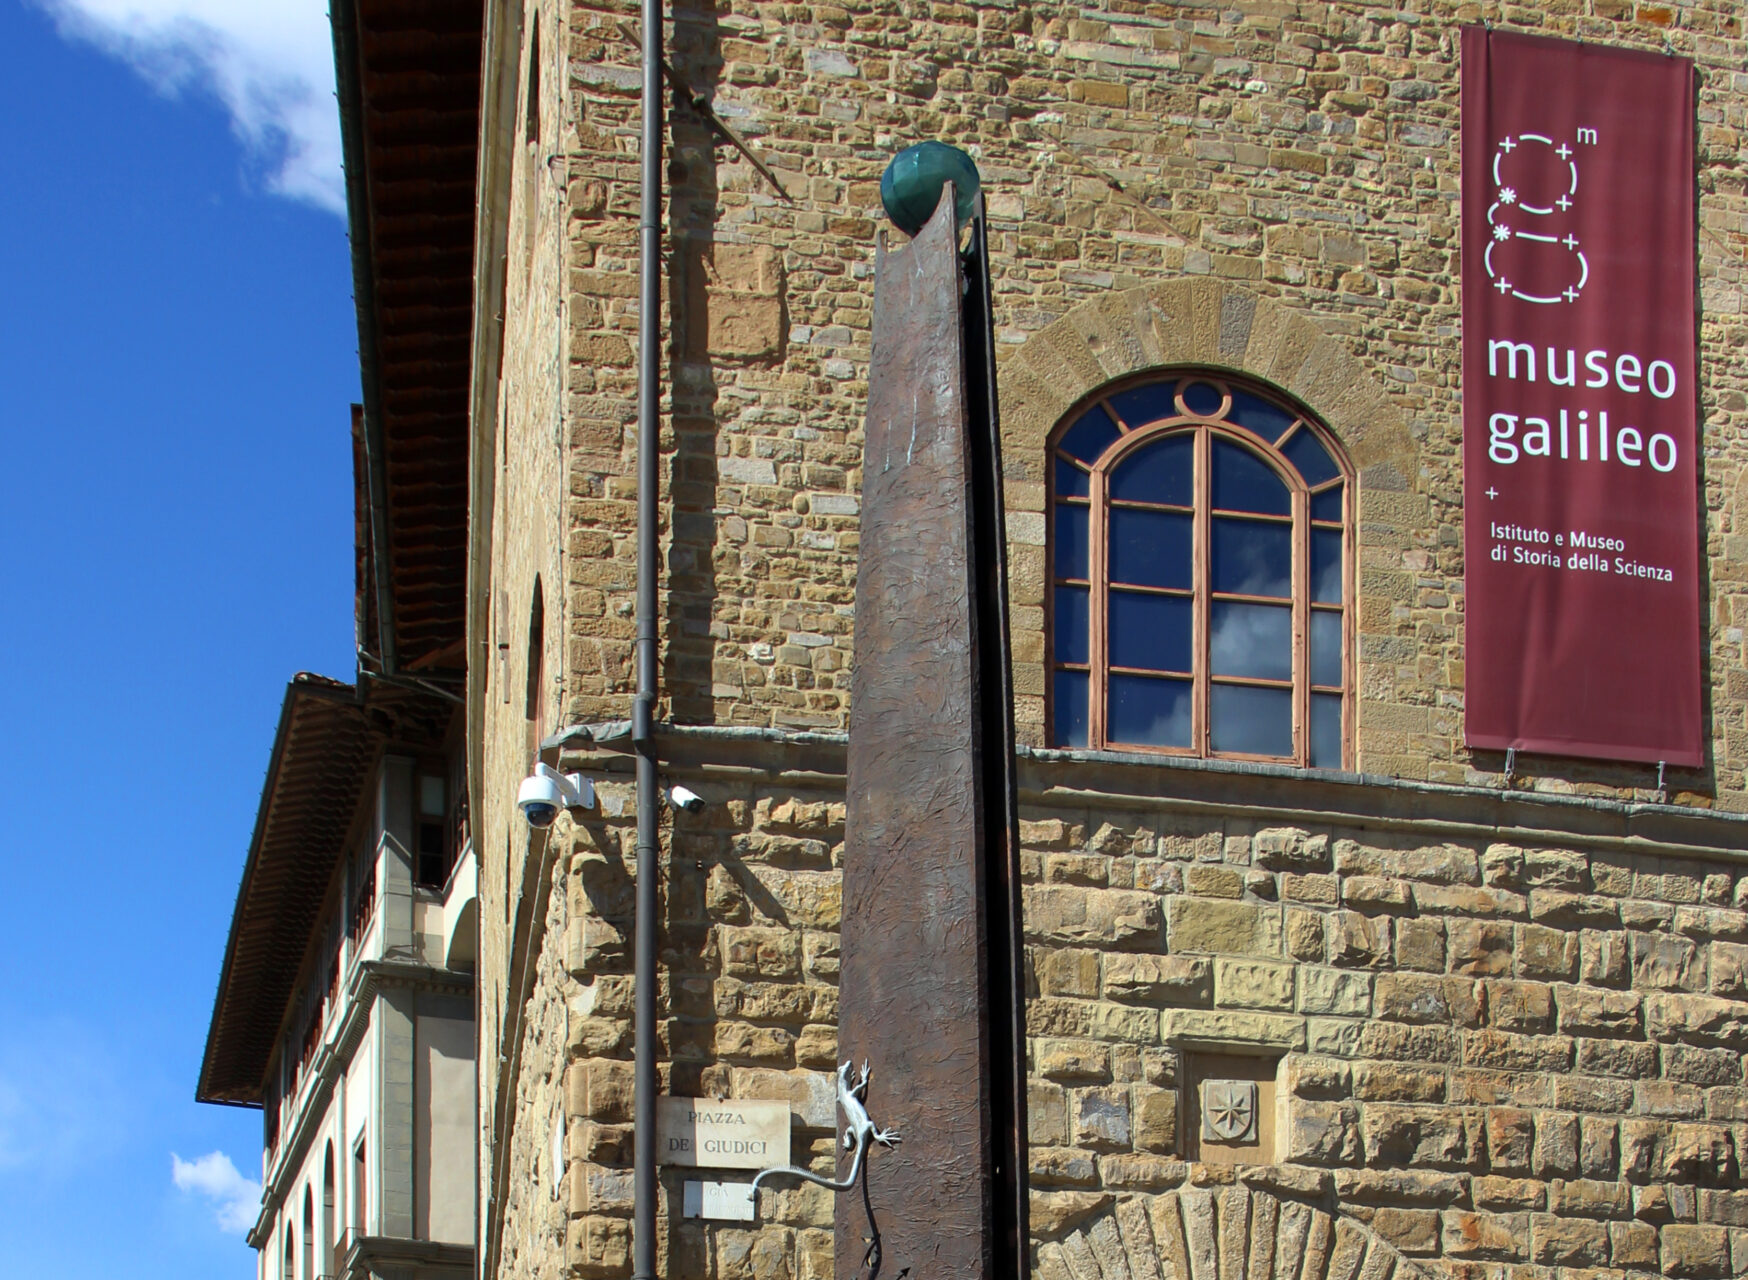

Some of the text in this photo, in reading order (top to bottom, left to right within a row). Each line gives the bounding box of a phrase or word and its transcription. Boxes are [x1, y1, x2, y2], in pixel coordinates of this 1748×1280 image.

[1488, 338, 1677, 399] museo
[1488, 409, 1678, 473] galileo
[1490, 521, 1625, 552] Istituto e Museo
[1490, 544, 1674, 582] di Storia della Scienza
[687, 1111, 746, 1124] PIAZZA
[704, 1140, 767, 1154] GIUDICI
